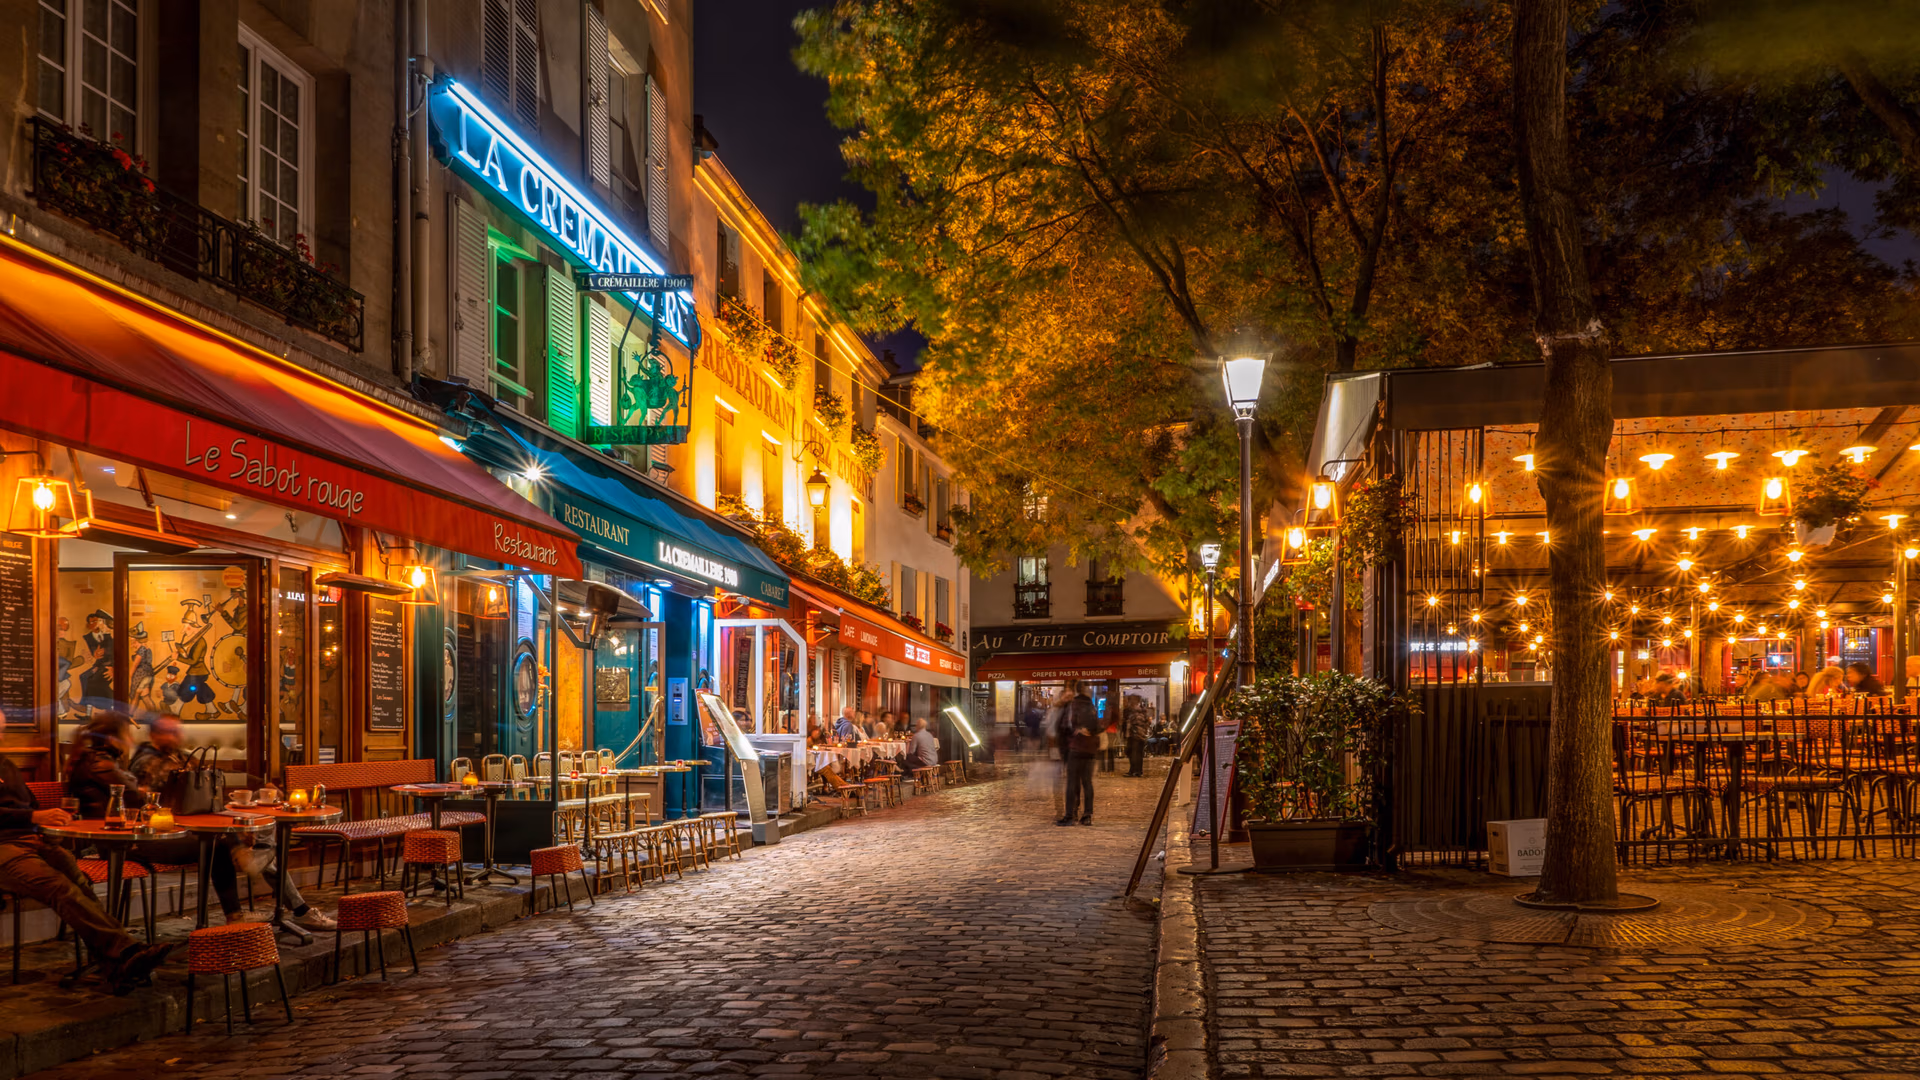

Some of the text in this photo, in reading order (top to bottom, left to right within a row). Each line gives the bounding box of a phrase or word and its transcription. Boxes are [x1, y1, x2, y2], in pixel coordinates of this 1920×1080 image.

[458, 106, 689, 342] LA CREMAILLRE
[582, 277, 594, 287] LA
[701, 329, 796, 434] RESTAURANT
[802, 420, 832, 470] CHEZ
[185, 420, 364, 519] Le Sabot rouge
[494, 521, 559, 566] Restaurant
[564, 503, 630, 546] RESTAURANT
[760, 580, 784, 602] CABARET
[1018, 632, 1068, 648] PETIT
[1082, 631, 1170, 647] COMPTOIR
[1081, 669, 1113, 677] BURGERS
